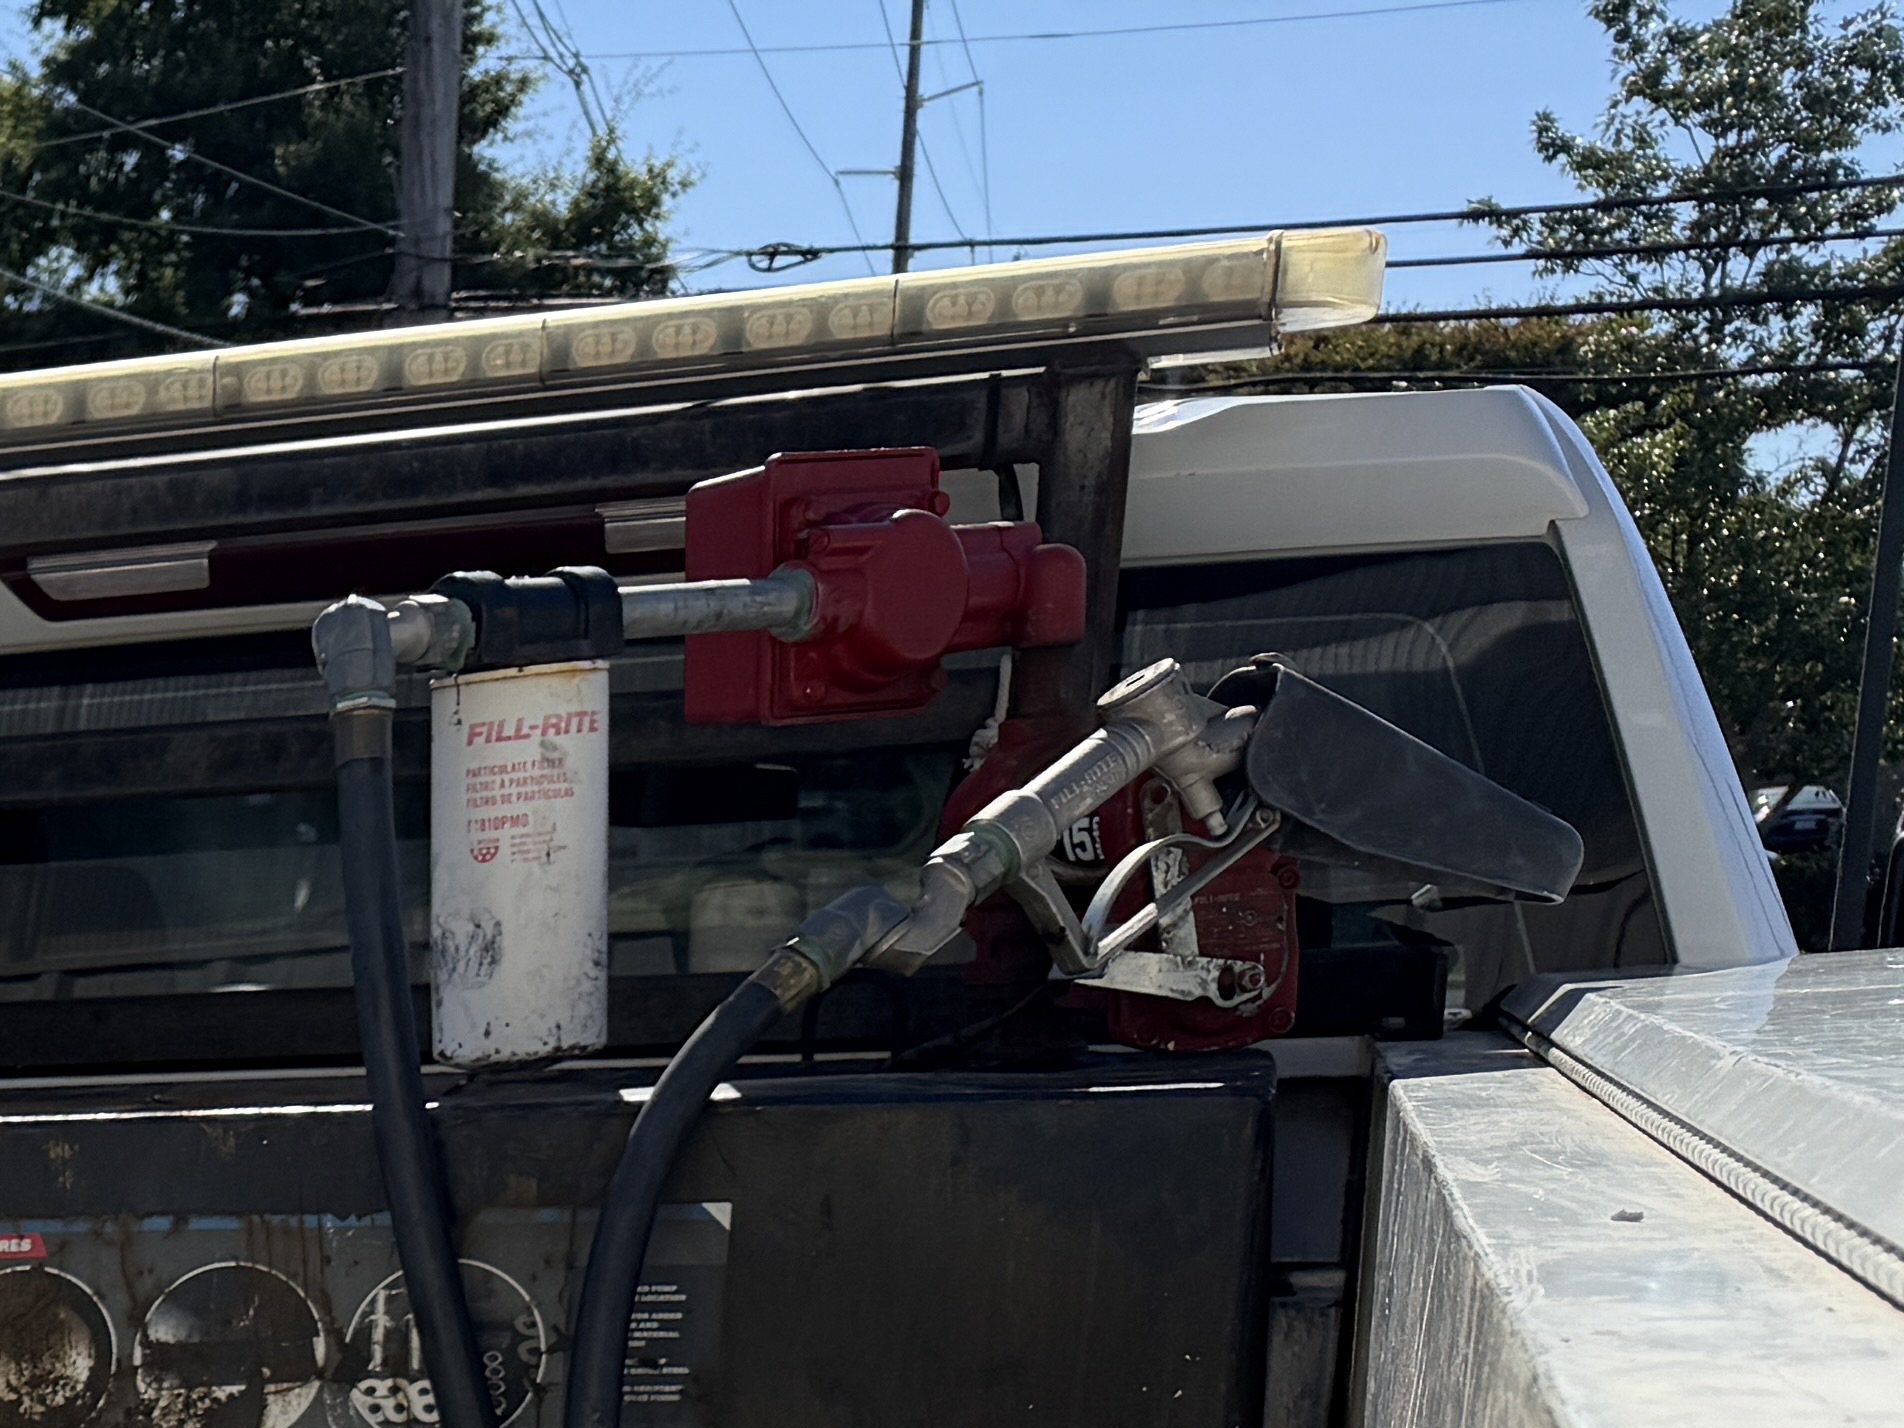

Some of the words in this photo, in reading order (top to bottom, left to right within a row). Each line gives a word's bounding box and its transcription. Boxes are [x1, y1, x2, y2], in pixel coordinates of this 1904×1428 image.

[465, 710, 600, 747] FILL-RITE
[465, 760, 528, 778] PARTICULATE
[1062, 816, 1095, 862] 15
